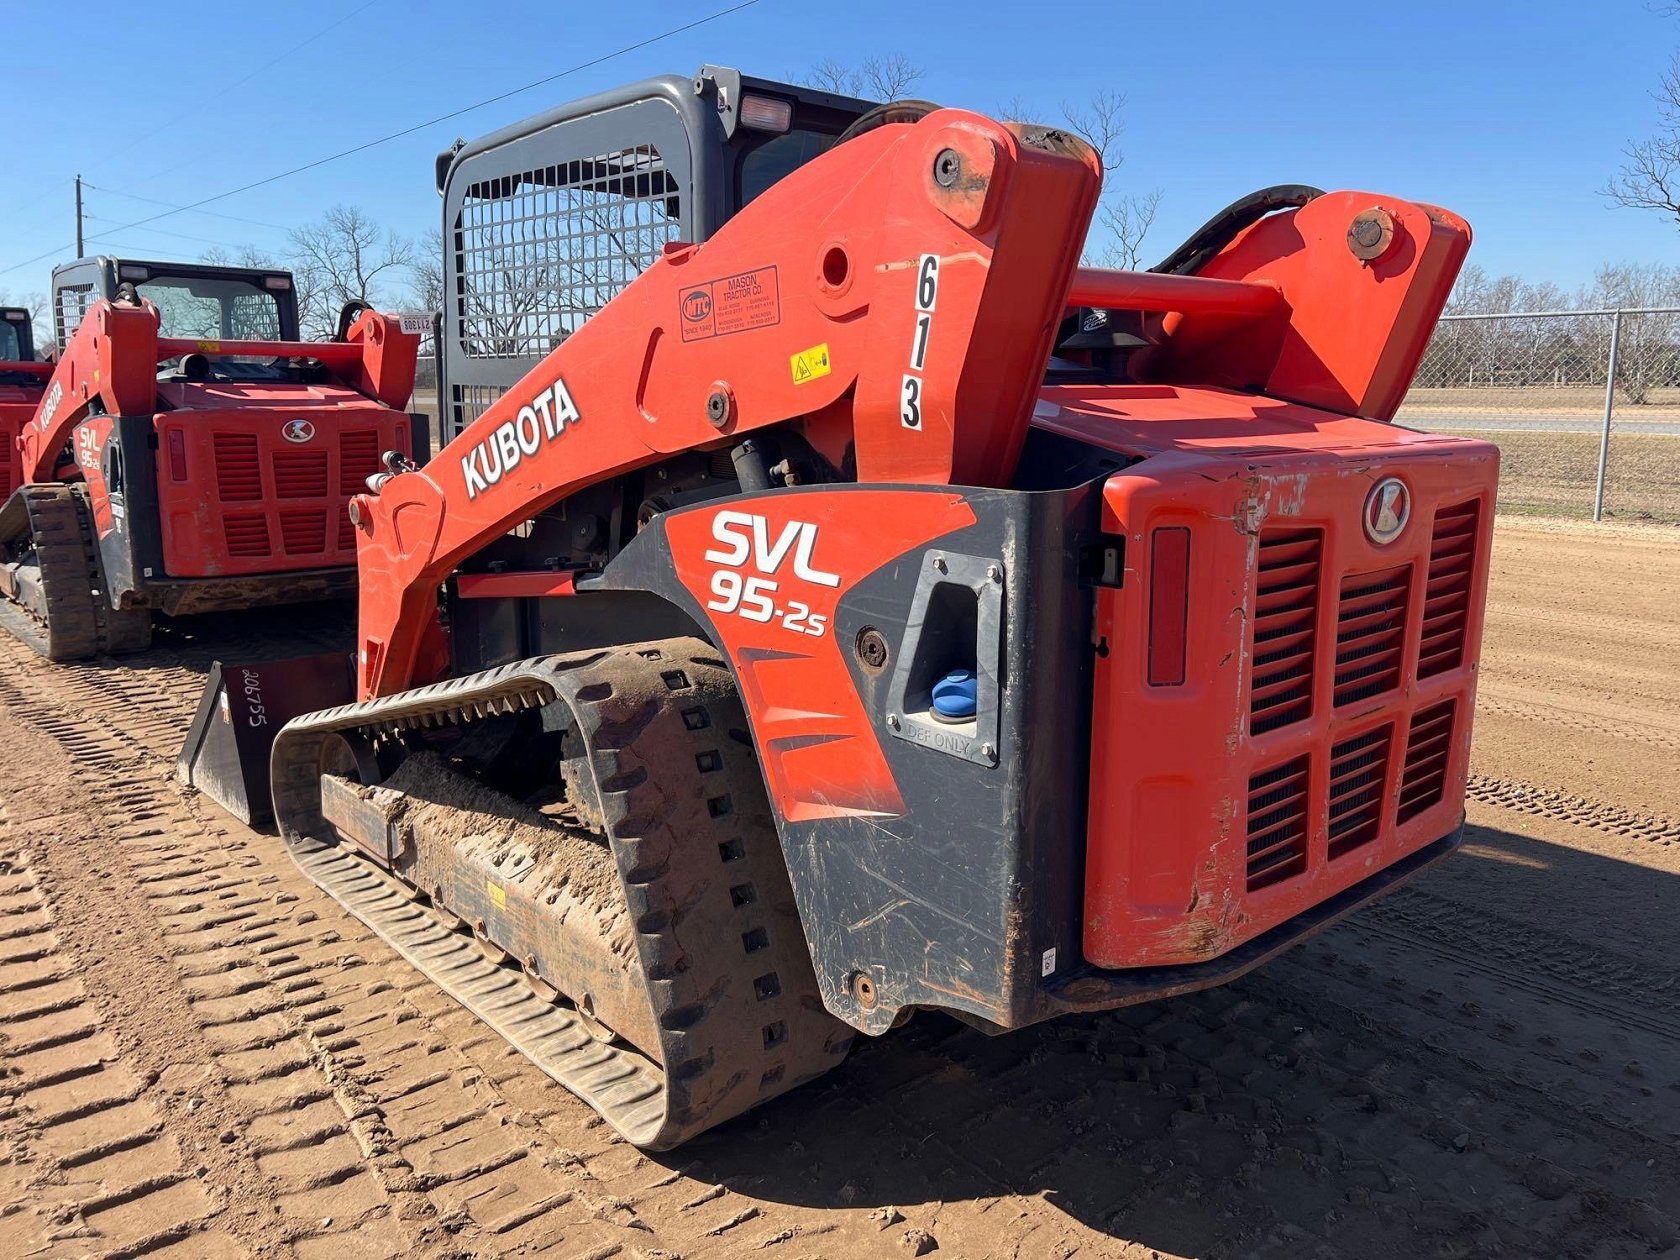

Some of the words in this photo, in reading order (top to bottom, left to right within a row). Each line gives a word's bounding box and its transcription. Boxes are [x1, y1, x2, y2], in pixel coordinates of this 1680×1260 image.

[723, 287, 752, 302] TRACTOR
[728, 273, 757, 291] MASON
[79, 427, 101, 452] SVL
[461, 378, 582, 500] KUBOTA
[705, 510, 840, 587] SVL
[242, 668, 267, 728] 206755
[906, 724, 931, 742] DEF
[934, 733, 971, 755] ONLY
